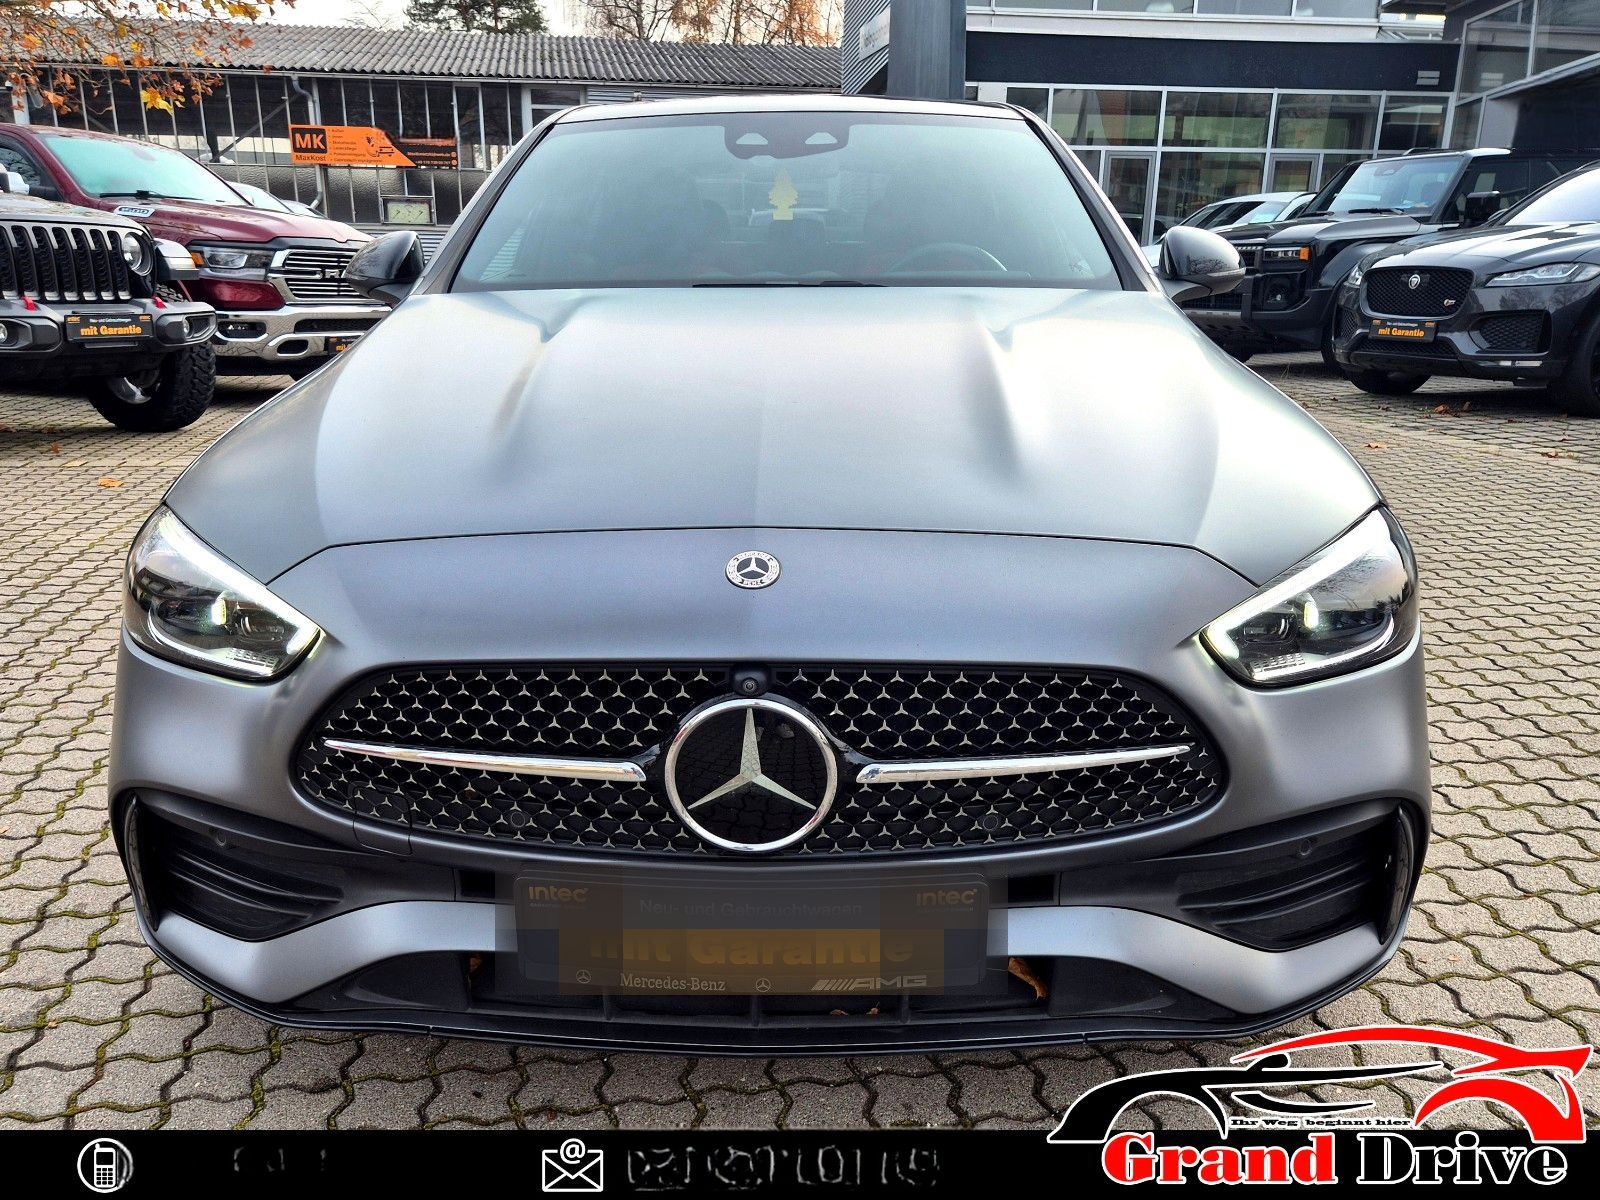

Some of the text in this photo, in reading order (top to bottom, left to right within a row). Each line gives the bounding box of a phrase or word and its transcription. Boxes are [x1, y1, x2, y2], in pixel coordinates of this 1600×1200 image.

[295, 133, 325, 149] MK
[80, 324, 142, 336] mit Garantie
[1378, 327, 1425, 337] mit Garantie
[529, 885, 589, 903] intec
[916, 888, 978, 906] intec
[640, 899, 863, 917] Neu- und Gebrauchtwagen
[590, 929, 914, 966] mit Garantie
[620, 973, 726, 992] Mercedes-Benz
